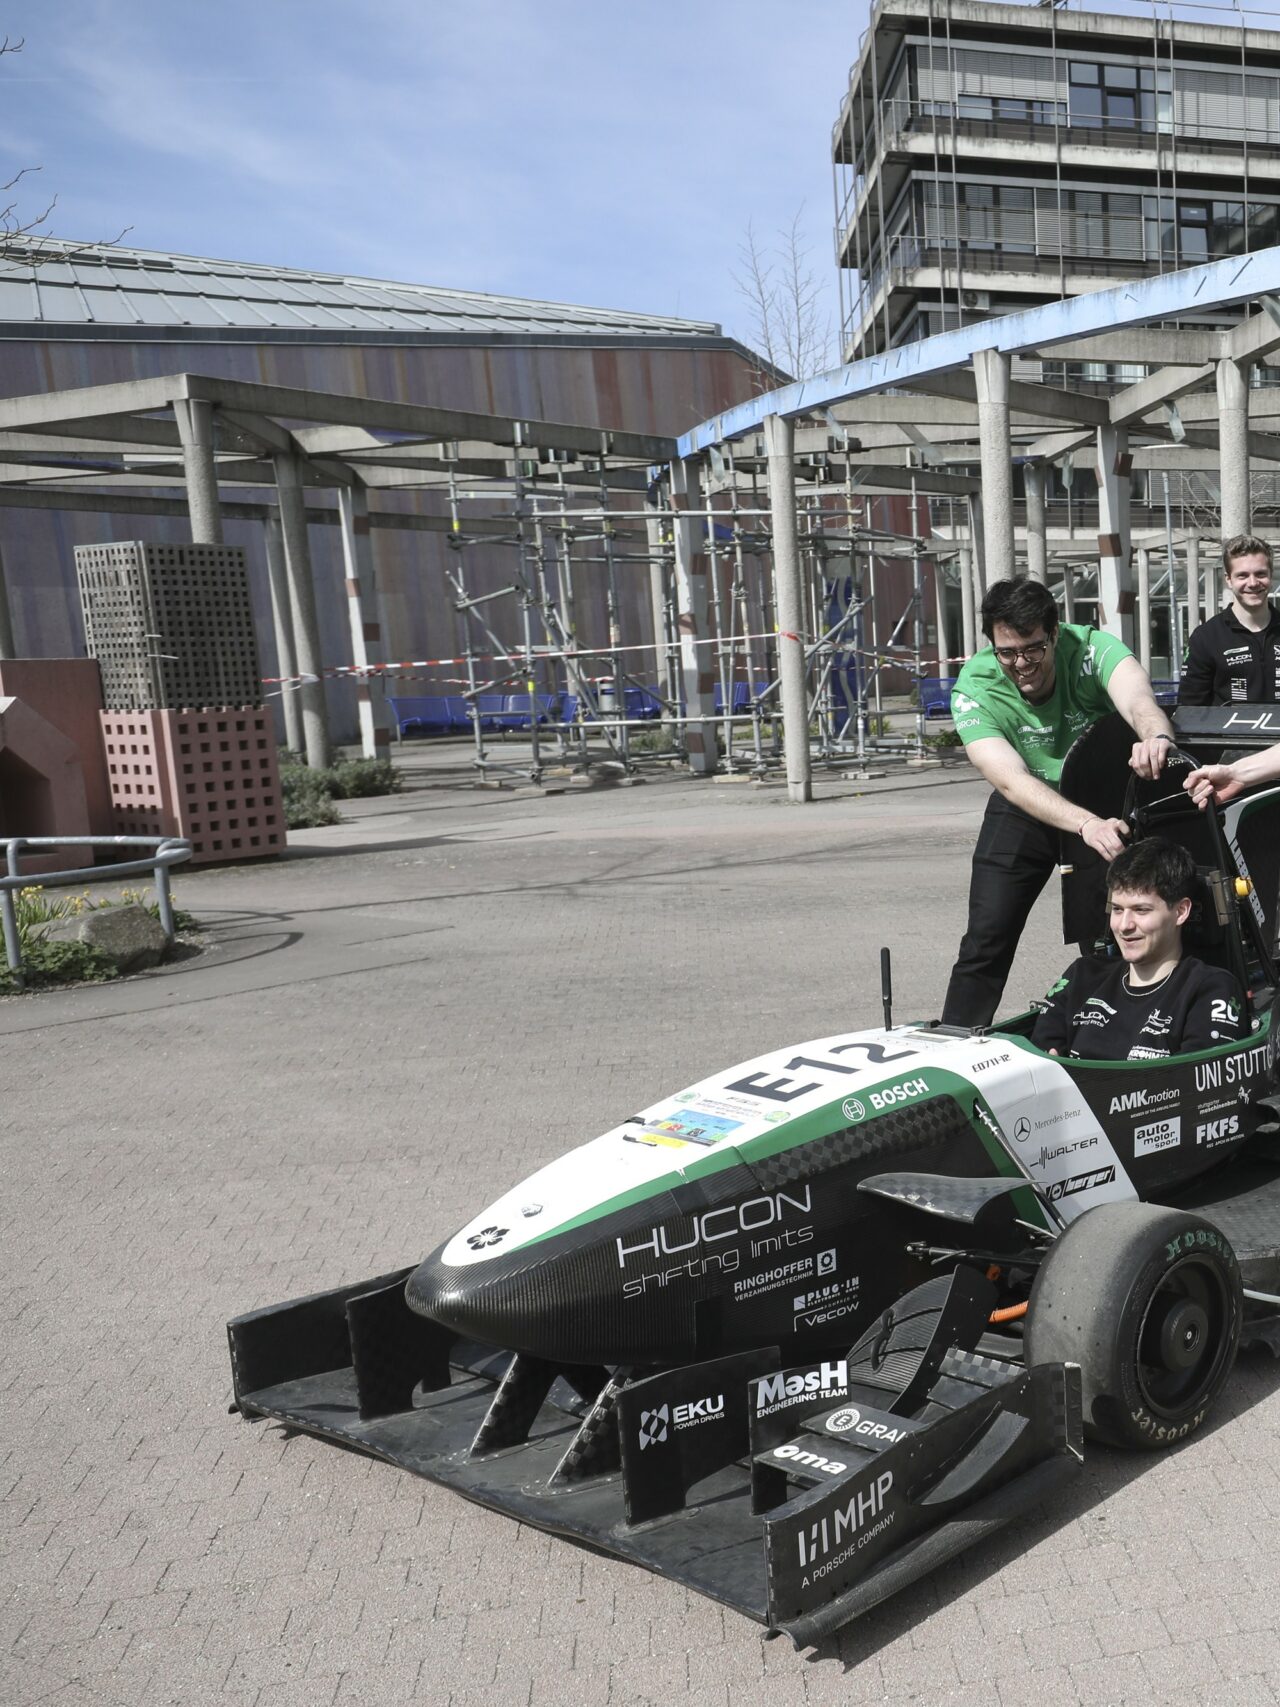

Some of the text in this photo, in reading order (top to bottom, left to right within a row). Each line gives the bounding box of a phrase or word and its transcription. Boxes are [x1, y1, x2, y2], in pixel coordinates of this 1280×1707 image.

[1229, 838, 1266, 928] LIEBERR
[723, 1043, 920, 1102] E12
[1195, 1060, 1222, 1092] UNI
[1225, 1044, 1273, 1083] STUTTG
[869, 1077, 930, 1110] BOSCH
[1109, 1088, 1180, 1115] AMKmotion
[1034, 1109, 1082, 1130] Mercedes-Benz
[1137, 1123, 1170, 1140] auto
[1196, 1115, 1239, 1145] FKFS
[1046, 1137, 1098, 1161] WALTER
[1143, 1130, 1175, 1145] motor
[1154, 1137, 1178, 1149] sport
[616, 1184, 812, 1268] HUCON
[623, 1225, 814, 1299] shifting limits
[734, 1257, 813, 1293] RINGHOFFER
[734, 1269, 814, 1302] VERZAHNUNGSTECHNIK
[672, 1395, 724, 1424] EKU
[757, 1387, 848, 1419] ENGINEERING TEAM
[673, 1412, 725, 1431] POWER DRIVES
[773, 1445, 847, 1475] oma
[834, 1470, 893, 1545] MHP
[801, 1511, 895, 1589] A PORSCHE COMPANY
